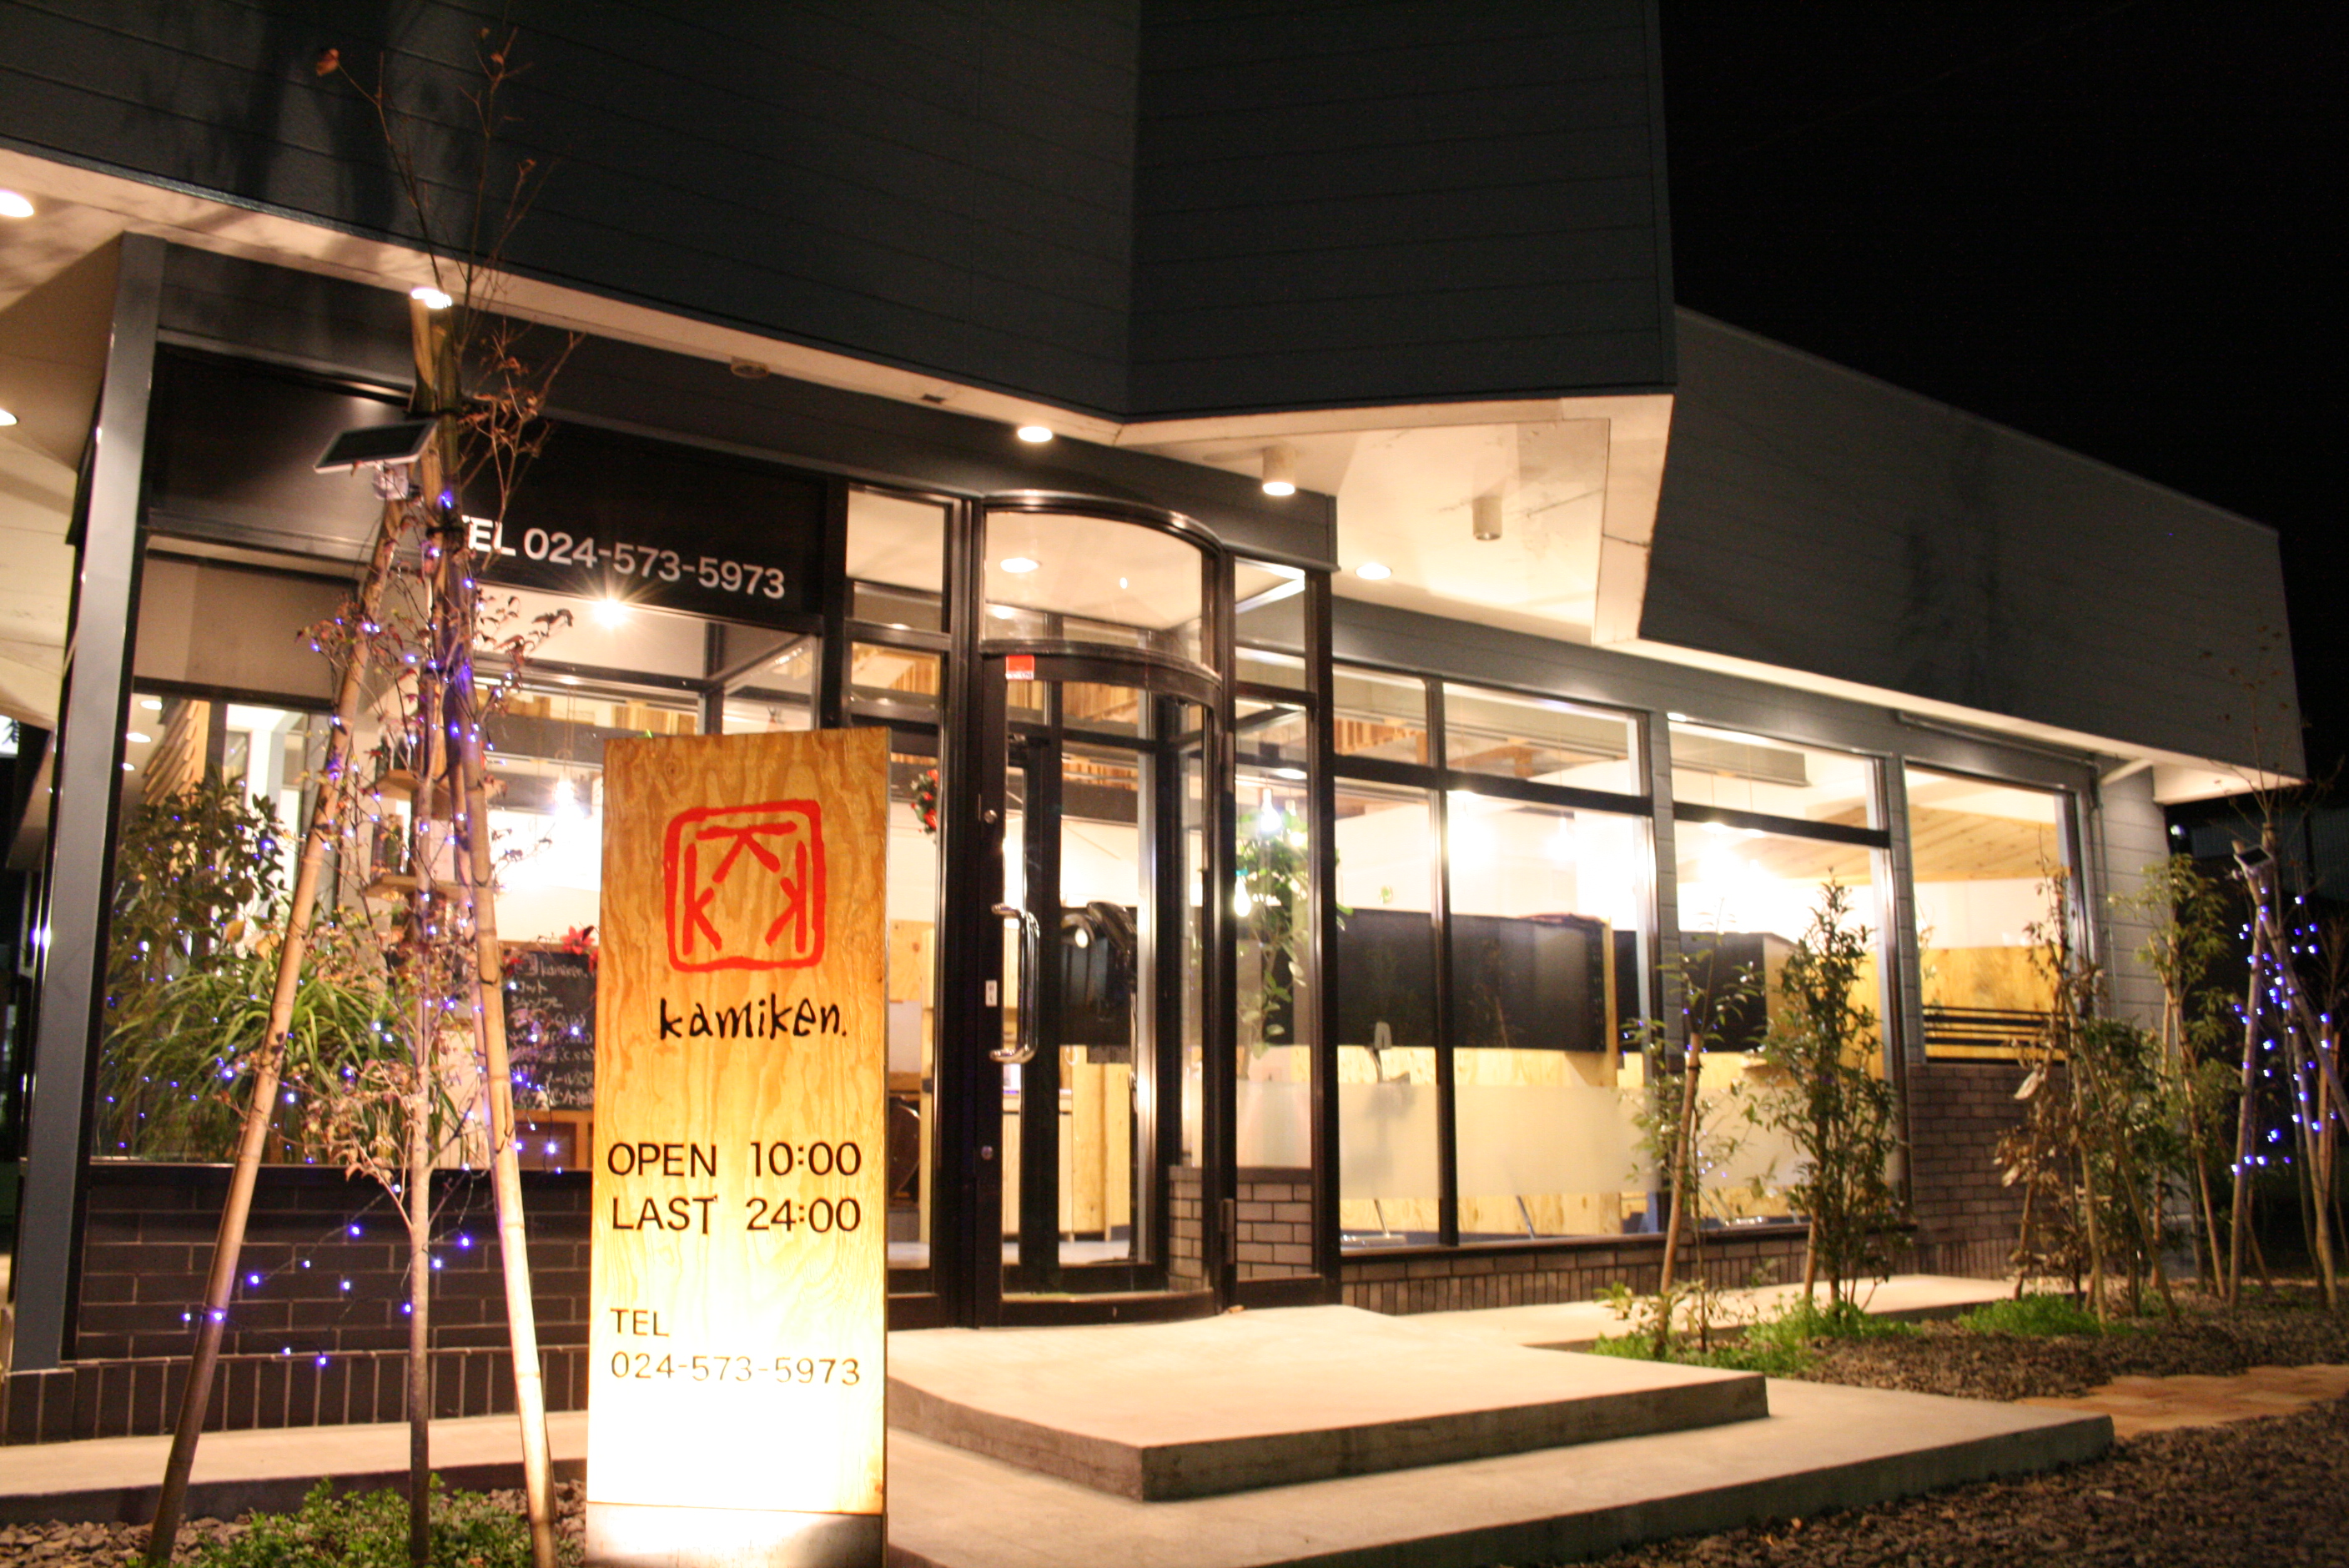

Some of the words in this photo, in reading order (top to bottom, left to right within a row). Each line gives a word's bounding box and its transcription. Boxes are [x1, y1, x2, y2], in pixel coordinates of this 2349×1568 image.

[461, 515, 516, 557] EL
[524, 527, 786, 600] 024-573-5973
[660, 993, 848, 1040] kamiken.
[607, 1141, 717, 1178] OPEN
[750, 1141, 862, 1178] 10:00
[612, 1194, 718, 1235] LAST
[746, 1197, 862, 1234] 24:00
[610, 1307, 670, 1337] TEL
[611, 1350, 861, 1386] 024-573-5973
